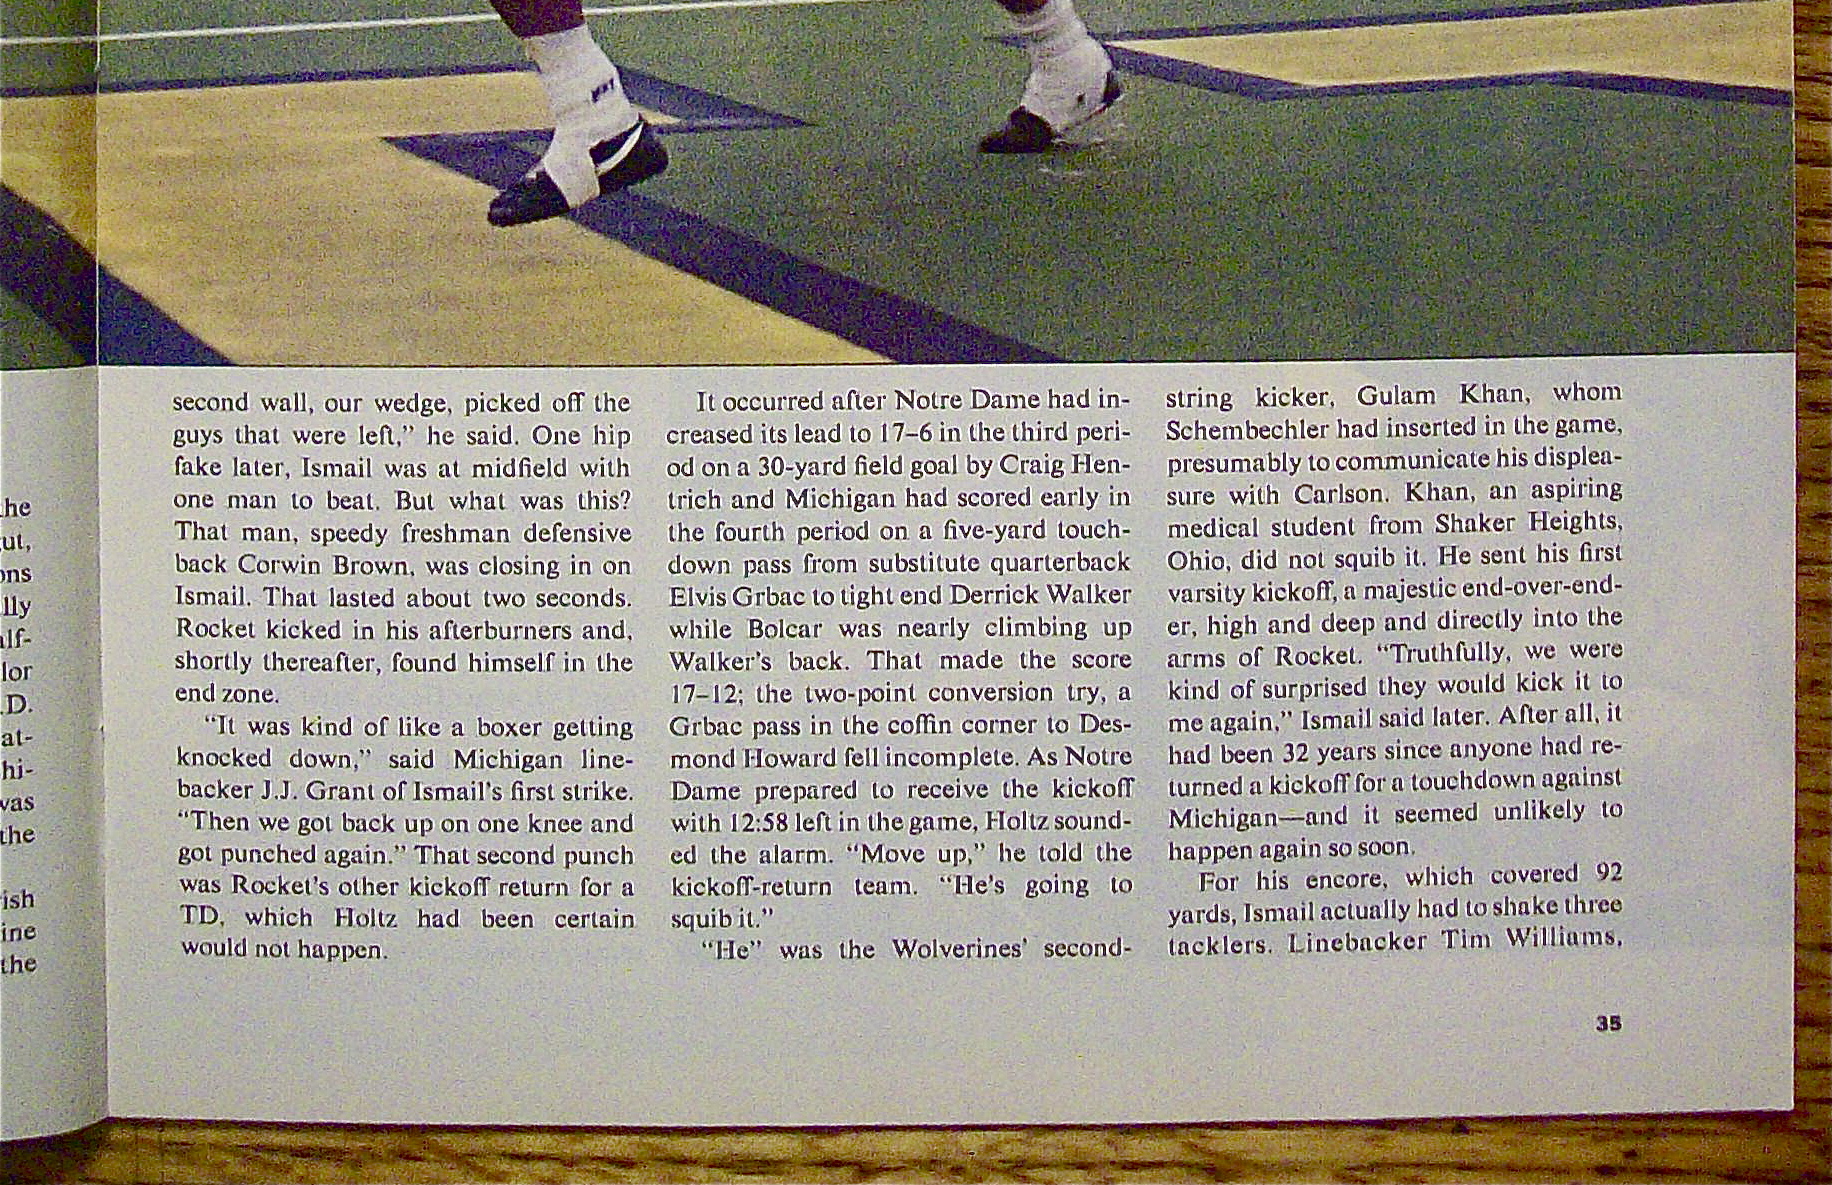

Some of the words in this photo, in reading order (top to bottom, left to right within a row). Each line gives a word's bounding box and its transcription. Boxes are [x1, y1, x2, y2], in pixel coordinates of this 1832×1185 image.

[173, 392, 248, 412] second
[260, 392, 314, 415] wall,
[325, 398, 363, 413] our
[374, 392, 452, 417] wedge,
[465, 392, 540, 417] picked
[553, 392, 585, 412] off
[595, 392, 631, 412] the
[697, 392, 715, 412] It
[723, 390, 823, 412] occurred
[832, 389, 886, 410] after
[894, 389, 962, 410] Notre
[970, 389, 1040, 409] Dame
[1048, 388, 1090, 409] had
[1099, 387, 1130, 408] in-
[1167, 387, 1233, 412] string
[1256, 386, 1334, 409] kicker,
[1358, 385, 1435, 406] Gulam
[1459, 383, 1530, 406] Khan,
[1553, 381, 1622, 401] whom
[1166, 419, 1330, 441] Schembechler
[1337, 418, 1378, 438] had
[1387, 416, 1476, 438] inserted
[1485, 414, 1505, 436] in
[1515, 414, 1548, 435] the
[1555, 418, 1622, 438] game,
[175, 455, 222, 476] fake
[233, 457, 290, 479] later,
[301, 457, 372, 478] Ismail
[385, 463, 427, 478] was
[439, 460, 460, 478] at
[472, 457, 566, 478] midfield
[580, 457, 629, 478] with
[667, 457, 694, 477] od
[702, 462, 730, 477] on
[738, 462, 750, 476] a
[759, 455, 846, 480] 30-yard
[855, 454, 902, 475] field
[910, 454, 957, 480] goal
[967, 454, 993, 479] by
[1000, 453, 1064, 478] Craig
[1071, 453, 1130, 474] Hen-
[0, 497, 31, 518] he
[174, 520, 228, 541] That
[242, 527, 298, 545] man,
[311, 523, 388, 547] speedy
[402, 522, 510, 543] freshman
[524, 522, 632, 543] defensive
[1168, 517, 1258, 538] medical
[1271, 516, 1355, 537] student
[1370, 514, 1422, 535] from
[1436, 512, 1516, 533] Shaker
[1528, 510, 1622, 535] Heights,
[0, 533, 30, 553] ut,
[668, 554, 730, 575] down
[744, 559, 791, 578] pass
[804, 553, 857, 573] from
[869, 551, 980, 573] substitute
[991, 550, 1130, 576] quarterback
[175, 585, 251, 606] Ismail.
[263, 586, 317, 607] That
[330, 587, 394, 608] lasted
[407, 588, 471, 608] about
[484, 591, 525, 608] two
[536, 587, 631, 608] seconds.
[1168, 582, 1245, 607] varsity
[1253, 580, 1337, 605] kickoff,
[1344, 586, 1356, 600] a
[1365, 577, 1456, 603] majestic
[1463, 573, 1622, 597] end-over-end-
[0, 595, 31, 619] lly
[669, 618, 732, 639] while
[747, 619, 822, 639] Bolcar
[839, 623, 881, 638] was
[898, 617, 970, 641] nearly
[986, 615, 1087, 641] climbing
[1104, 622, 1131, 640] up
[175, 650, 252, 675] shortly
[264, 651, 381, 676] thereafter,
[393, 652, 456, 672] found
[469, 651, 556, 672] himself
[564, 651, 584, 673] in
[597, 652, 633, 672] the
[177, 746, 271, 768] knocked
[389, 748, 434, 769] said
[454, 748, 562, 773] Michigan
[582, 748, 633, 769] line-
[1169, 744, 1210, 765] had
[1221, 744, 1273, 764] been
[1283, 743, 1309, 763] 32
[1317, 746, 1376, 766] years
[1385, 739, 1442, 760] since
[1450, 742, 1532, 762] anyone
[1541, 735, 1581, 756] had
[1592, 740, 1622, 755] re-
[670, 781, 740, 801] Dame
[755, 779, 857, 805] prepared
[873, 782, 893, 799] to
[908, 778, 989, 799] receive
[1003, 778, 1038, 798] the
[1053, 777, 1135, 798] kickoff
[1365, 804, 1379, 824] it
[1395, 802, 1477, 824] seemed
[1495, 799, 1585, 823] unlikely
[1602, 801, 1622, 818] to
[259, 817, 290, 831] we
[298, 816, 333, 836] got
[342, 812, 395, 833] back
[405, 818, 433, 837] up
[441, 818, 469, 833] on
[478, 818, 519, 833] one
[529, 813, 582, 833] knee
[591, 812, 633, 833] and
[671, 844, 696, 865] ed
[711, 845, 747, 865] the
[760, 844, 833, 864] alarm.
[999, 842, 1026, 863] he
[1040, 842, 1082, 862] told
[1097, 842, 1132, 862] the
[0, 889, 34, 910] ish
[1168, 903, 1236, 928] yards,
[1244, 901, 1314, 923] Ismail
[1321, 899, 1410, 923] actually
[1418, 898, 1458, 918] had
[1467, 900, 1487, 917] to
[1493, 895, 1558, 917] shake
[1565, 894, 1622, 915] three
[780, 945, 822, 960] was
[840, 939, 875, 959] the
[1044, 937, 1132, 958] second-
[1596, 1015, 1622, 1032] 35
